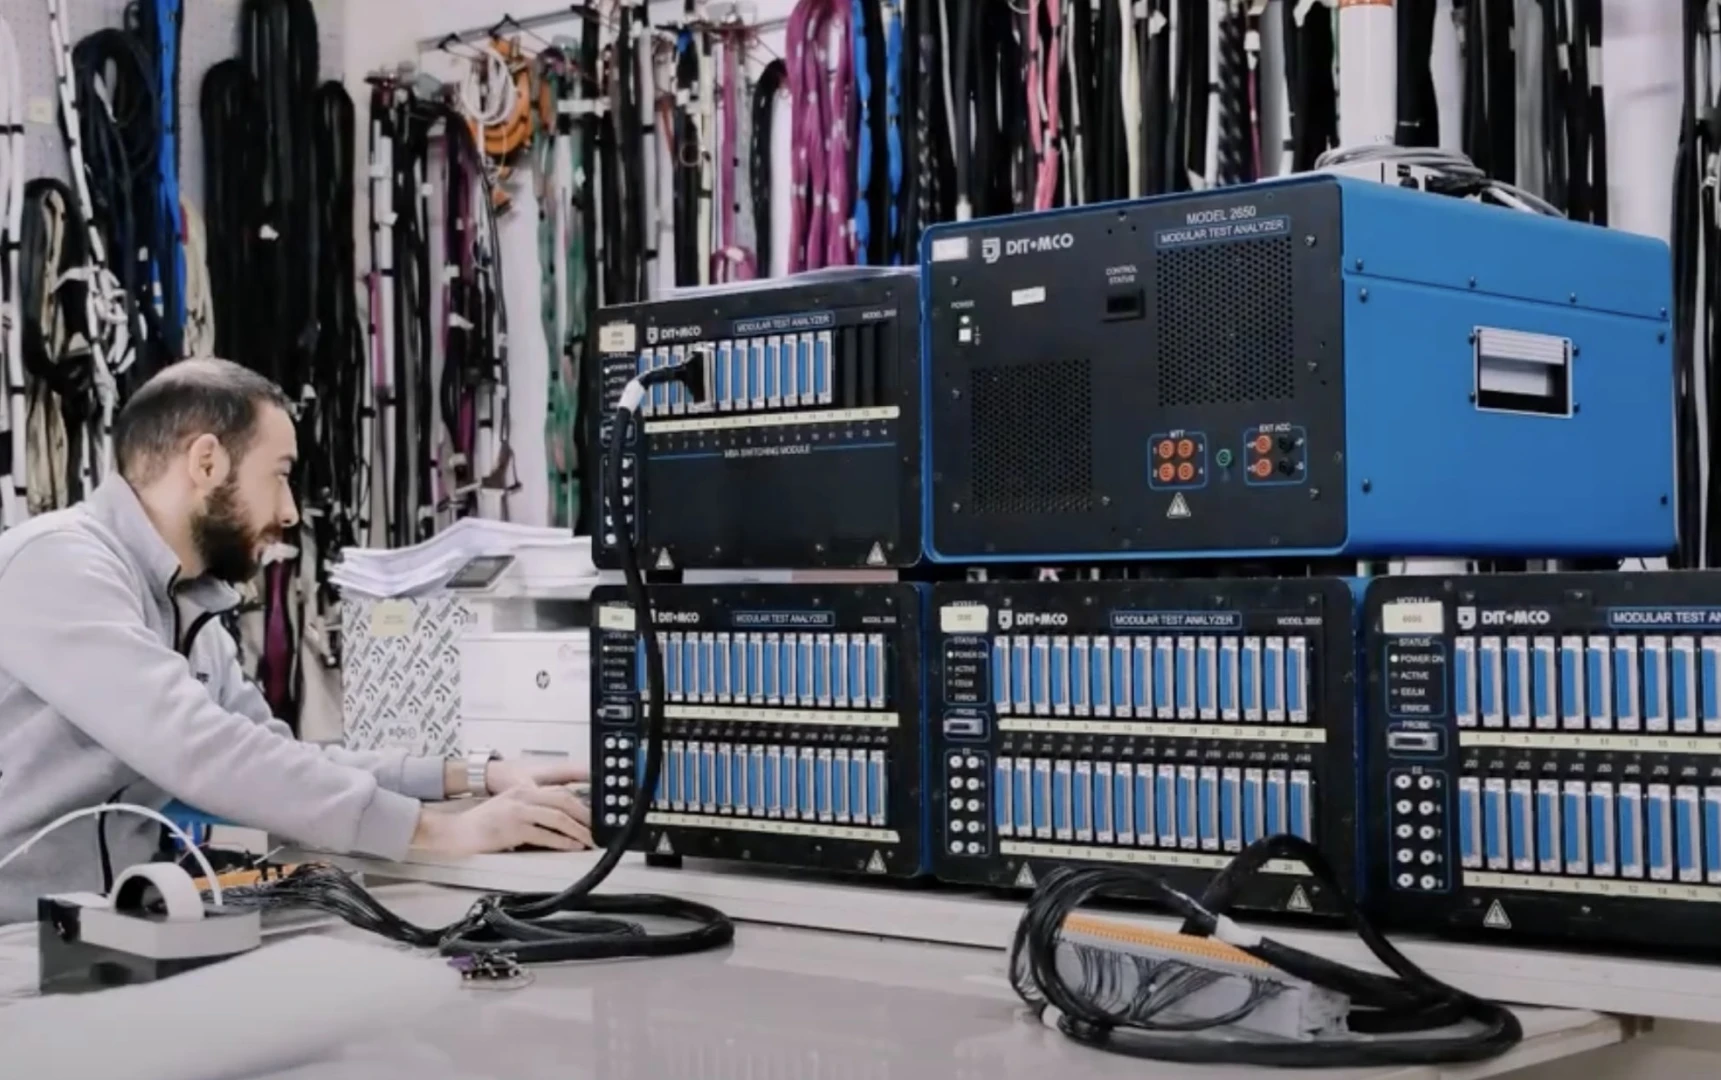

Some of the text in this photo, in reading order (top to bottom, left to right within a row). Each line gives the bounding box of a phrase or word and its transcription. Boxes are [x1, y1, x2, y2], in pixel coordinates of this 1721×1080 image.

[1186, 205, 1257, 225] MODEL 2650
[1160, 218, 1285, 244] MODULAR TEST ANALYZER
[1105, 263, 1138, 276] CONTROL
[1108, 274, 1136, 285] STATUS
[736, 313, 831, 333] MODULAR TEST ANALYZER
[735, 613, 828, 624] MODULAR TEST ANALYZER
[1114, 614, 1234, 626] MODULAR TEST ANALYZER
[1276, 616, 1304, 626] MODEL
[1612, 611, 1673, 624] MODULAR
[1675, 611, 1707, 624] TEST
[1399, 637, 1431, 647] STATUS
[1400, 653, 1445, 664] POWER ON
[1400, 670, 1430, 680] ACTIVE
[1400, 703, 1431, 713] ERROR
[1402, 720, 1431, 730] PROBE
